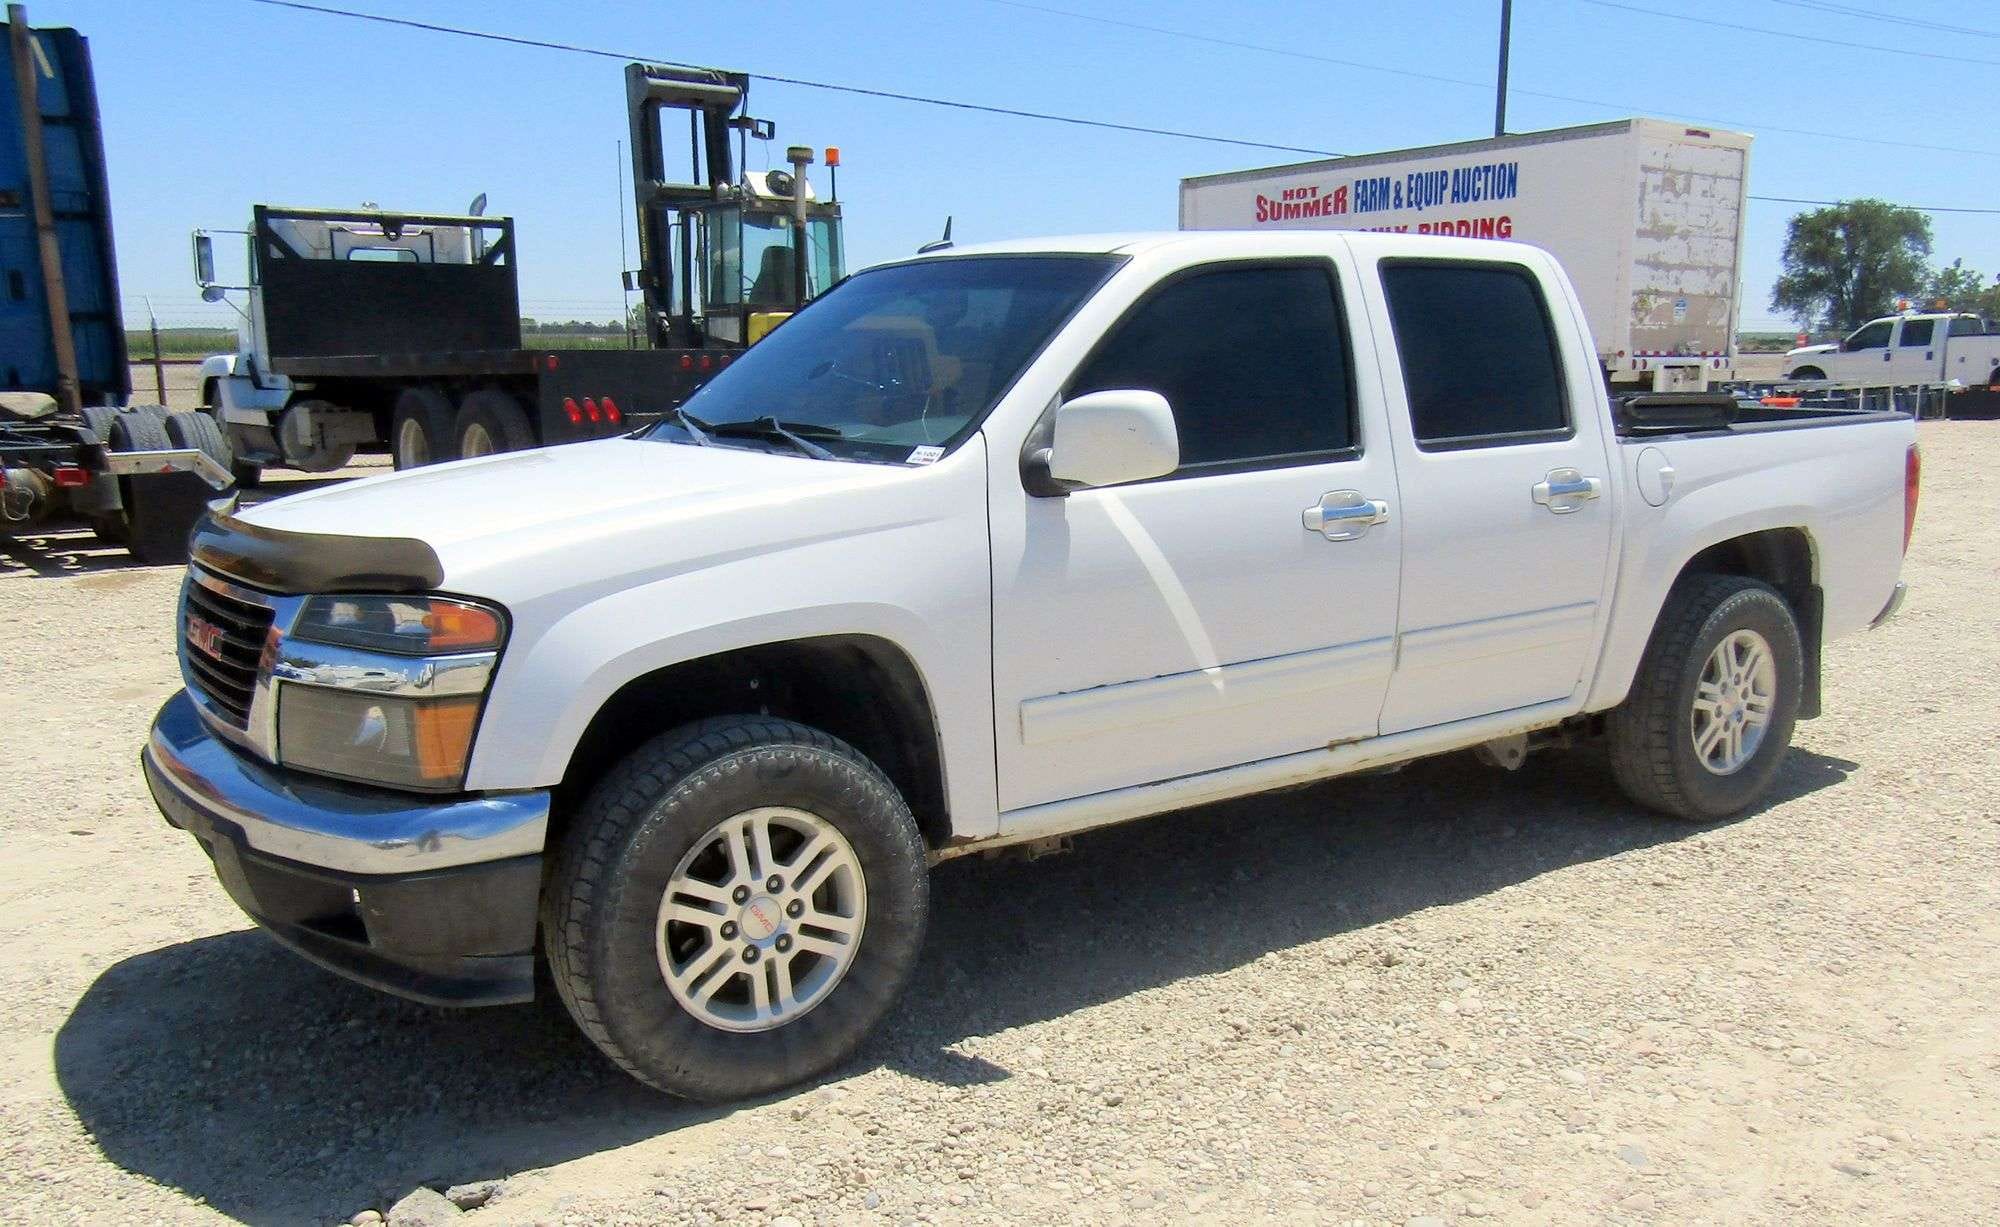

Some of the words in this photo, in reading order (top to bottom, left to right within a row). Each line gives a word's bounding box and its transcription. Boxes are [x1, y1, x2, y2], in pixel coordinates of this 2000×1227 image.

[1256, 185, 1348, 222] SUMMER
[1354, 177, 1391, 213] FARM
[1394, 181, 1404, 209] &
[1408, 170, 1449, 211] EQUIP
[1452, 162, 1518, 204] AUCTION
[1283, 187, 1319, 200] HOT
[186, 616, 222, 661] GMC
